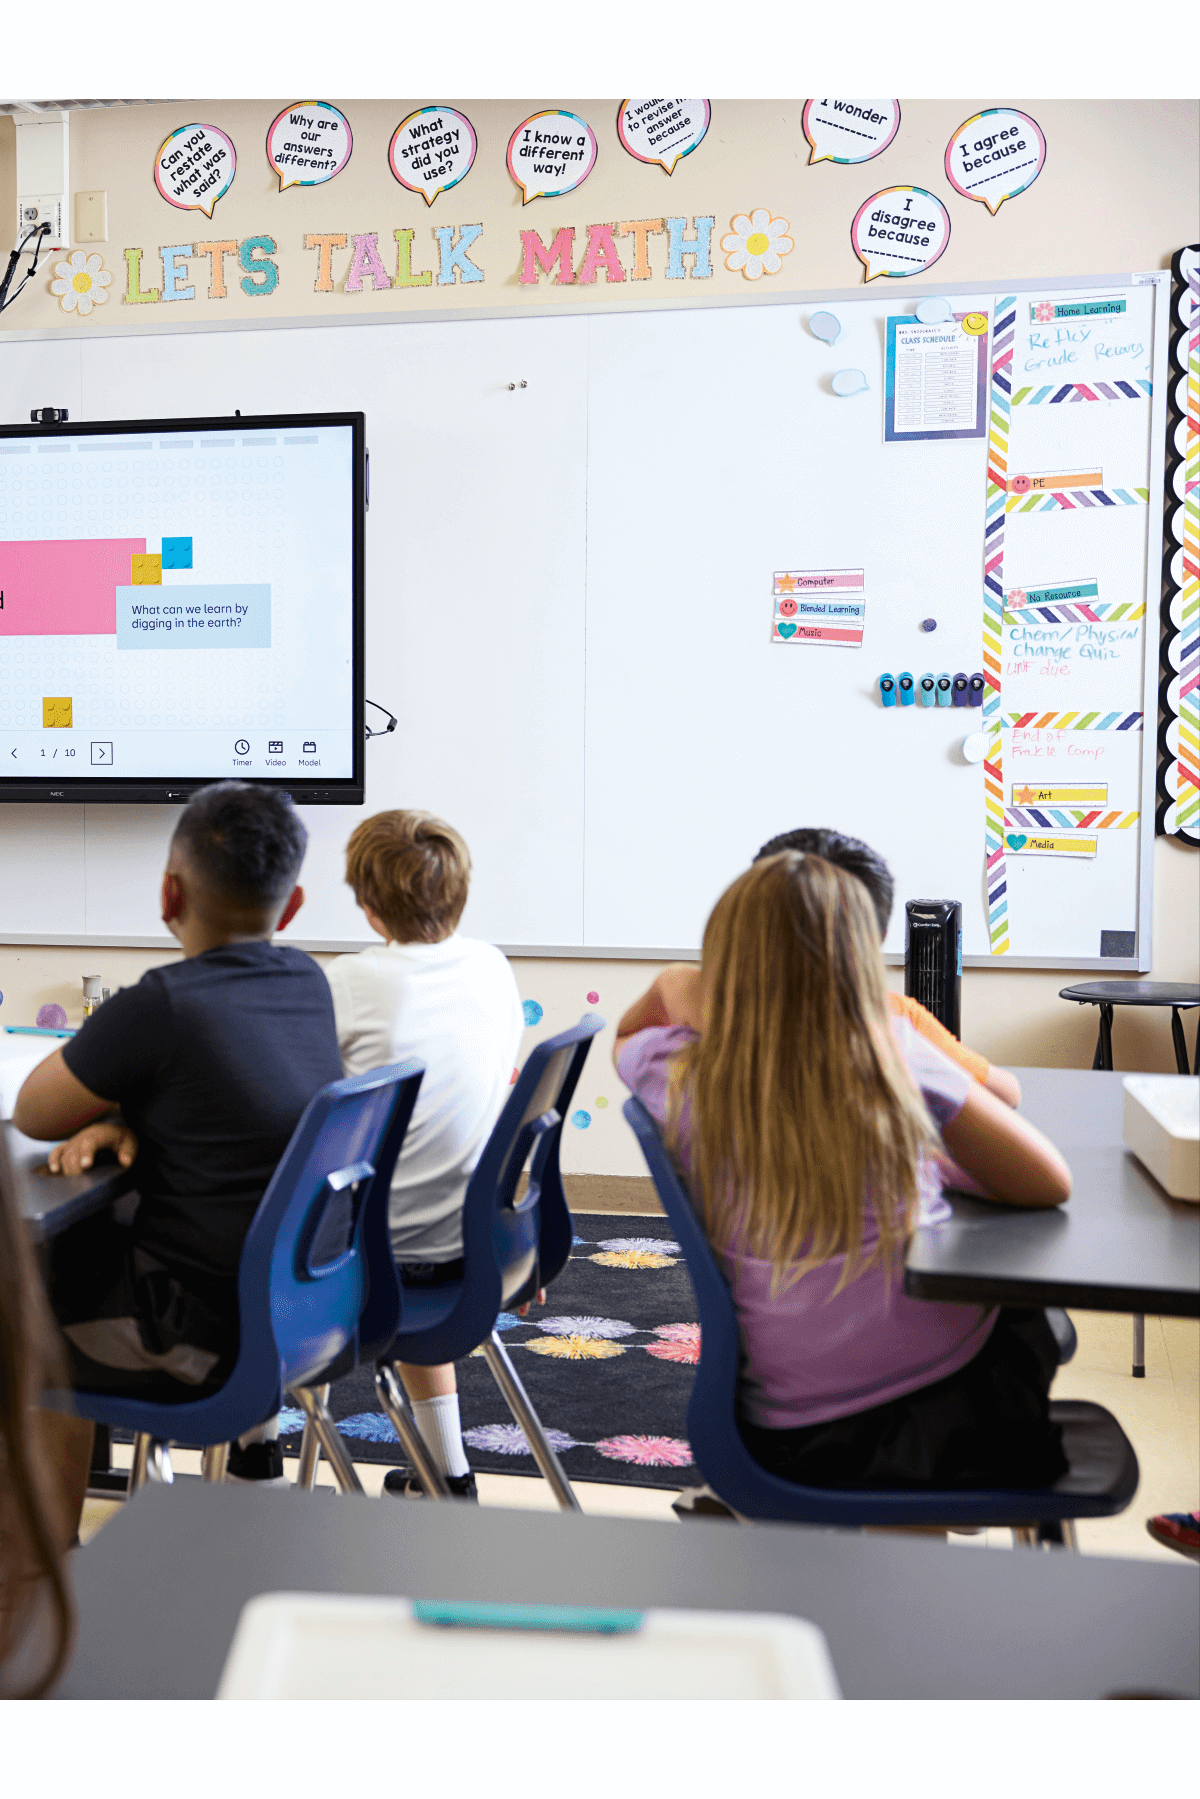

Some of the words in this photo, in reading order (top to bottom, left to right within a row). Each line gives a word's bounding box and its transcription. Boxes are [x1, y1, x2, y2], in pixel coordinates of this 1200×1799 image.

[625, 111, 633, 120] I
[628, 122, 639, 131] to
[642, 102, 674, 124] revise
[834, 100, 887, 125] wonder
[290, 114, 314, 129] Why
[318, 120, 338, 130] are
[409, 118, 443, 139] What
[647, 109, 682, 134] answer
[301, 132, 321, 141] our
[523, 130, 531, 142] I
[535, 131, 572, 145] know
[577, 137, 585, 146] a
[648, 118, 691, 145] because
[161, 150, 183, 169] Can
[184, 130, 205, 151] you
[284, 142, 333, 157] answers
[402, 129, 459, 158] strategy
[959, 144, 970, 157] I
[974, 126, 1019, 150] agree
[275, 153, 337, 170] different?
[412, 153, 431, 169] did
[435, 145, 459, 162] you
[520, 145, 584, 161] different
[962, 140, 1026, 172] because
[170, 143, 212, 181] restate
[423, 160, 453, 180] use?
[534, 163, 566, 176] way!
[173, 168, 201, 195] what
[203, 149, 226, 170] was
[193, 169, 221, 197] said?
[903, 198, 913, 211] I
[871, 210, 936, 231] disagree
[868, 225, 930, 246] because
[122, 234, 280, 304] LETS
[304, 223, 485, 294] TALK
[518, 216, 716, 286] MATH
[1057, 307, 1080, 316] Home
[1084, 304, 1121, 315] Learning
[923, 335, 956, 343] SCHEDULE
[1024, 349, 1078, 372] Grade
[1033, 478, 1045, 488] PE
[798, 577, 834, 587] Computer
[1029, 593, 1041, 602] No
[1044, 590, 1081, 601] Resource
[132, 604, 160, 615] What
[163, 606, 183, 614] can
[204, 604, 232, 614] learn
[235, 603, 248, 615] by
[800, 604, 826, 613] Blended
[828, 605, 860, 615] Learning
[132, 618, 172, 630] digging
[175, 618, 184, 628] in
[188, 618, 204, 628] the
[208, 617, 242, 628] earth?
[799, 627, 822, 637] Music
[1080, 643, 1120, 660] Quiz
[1040, 659, 1070, 677] due
[1038, 791, 1052, 800] Art
[1030, 839, 1054, 849] Media
